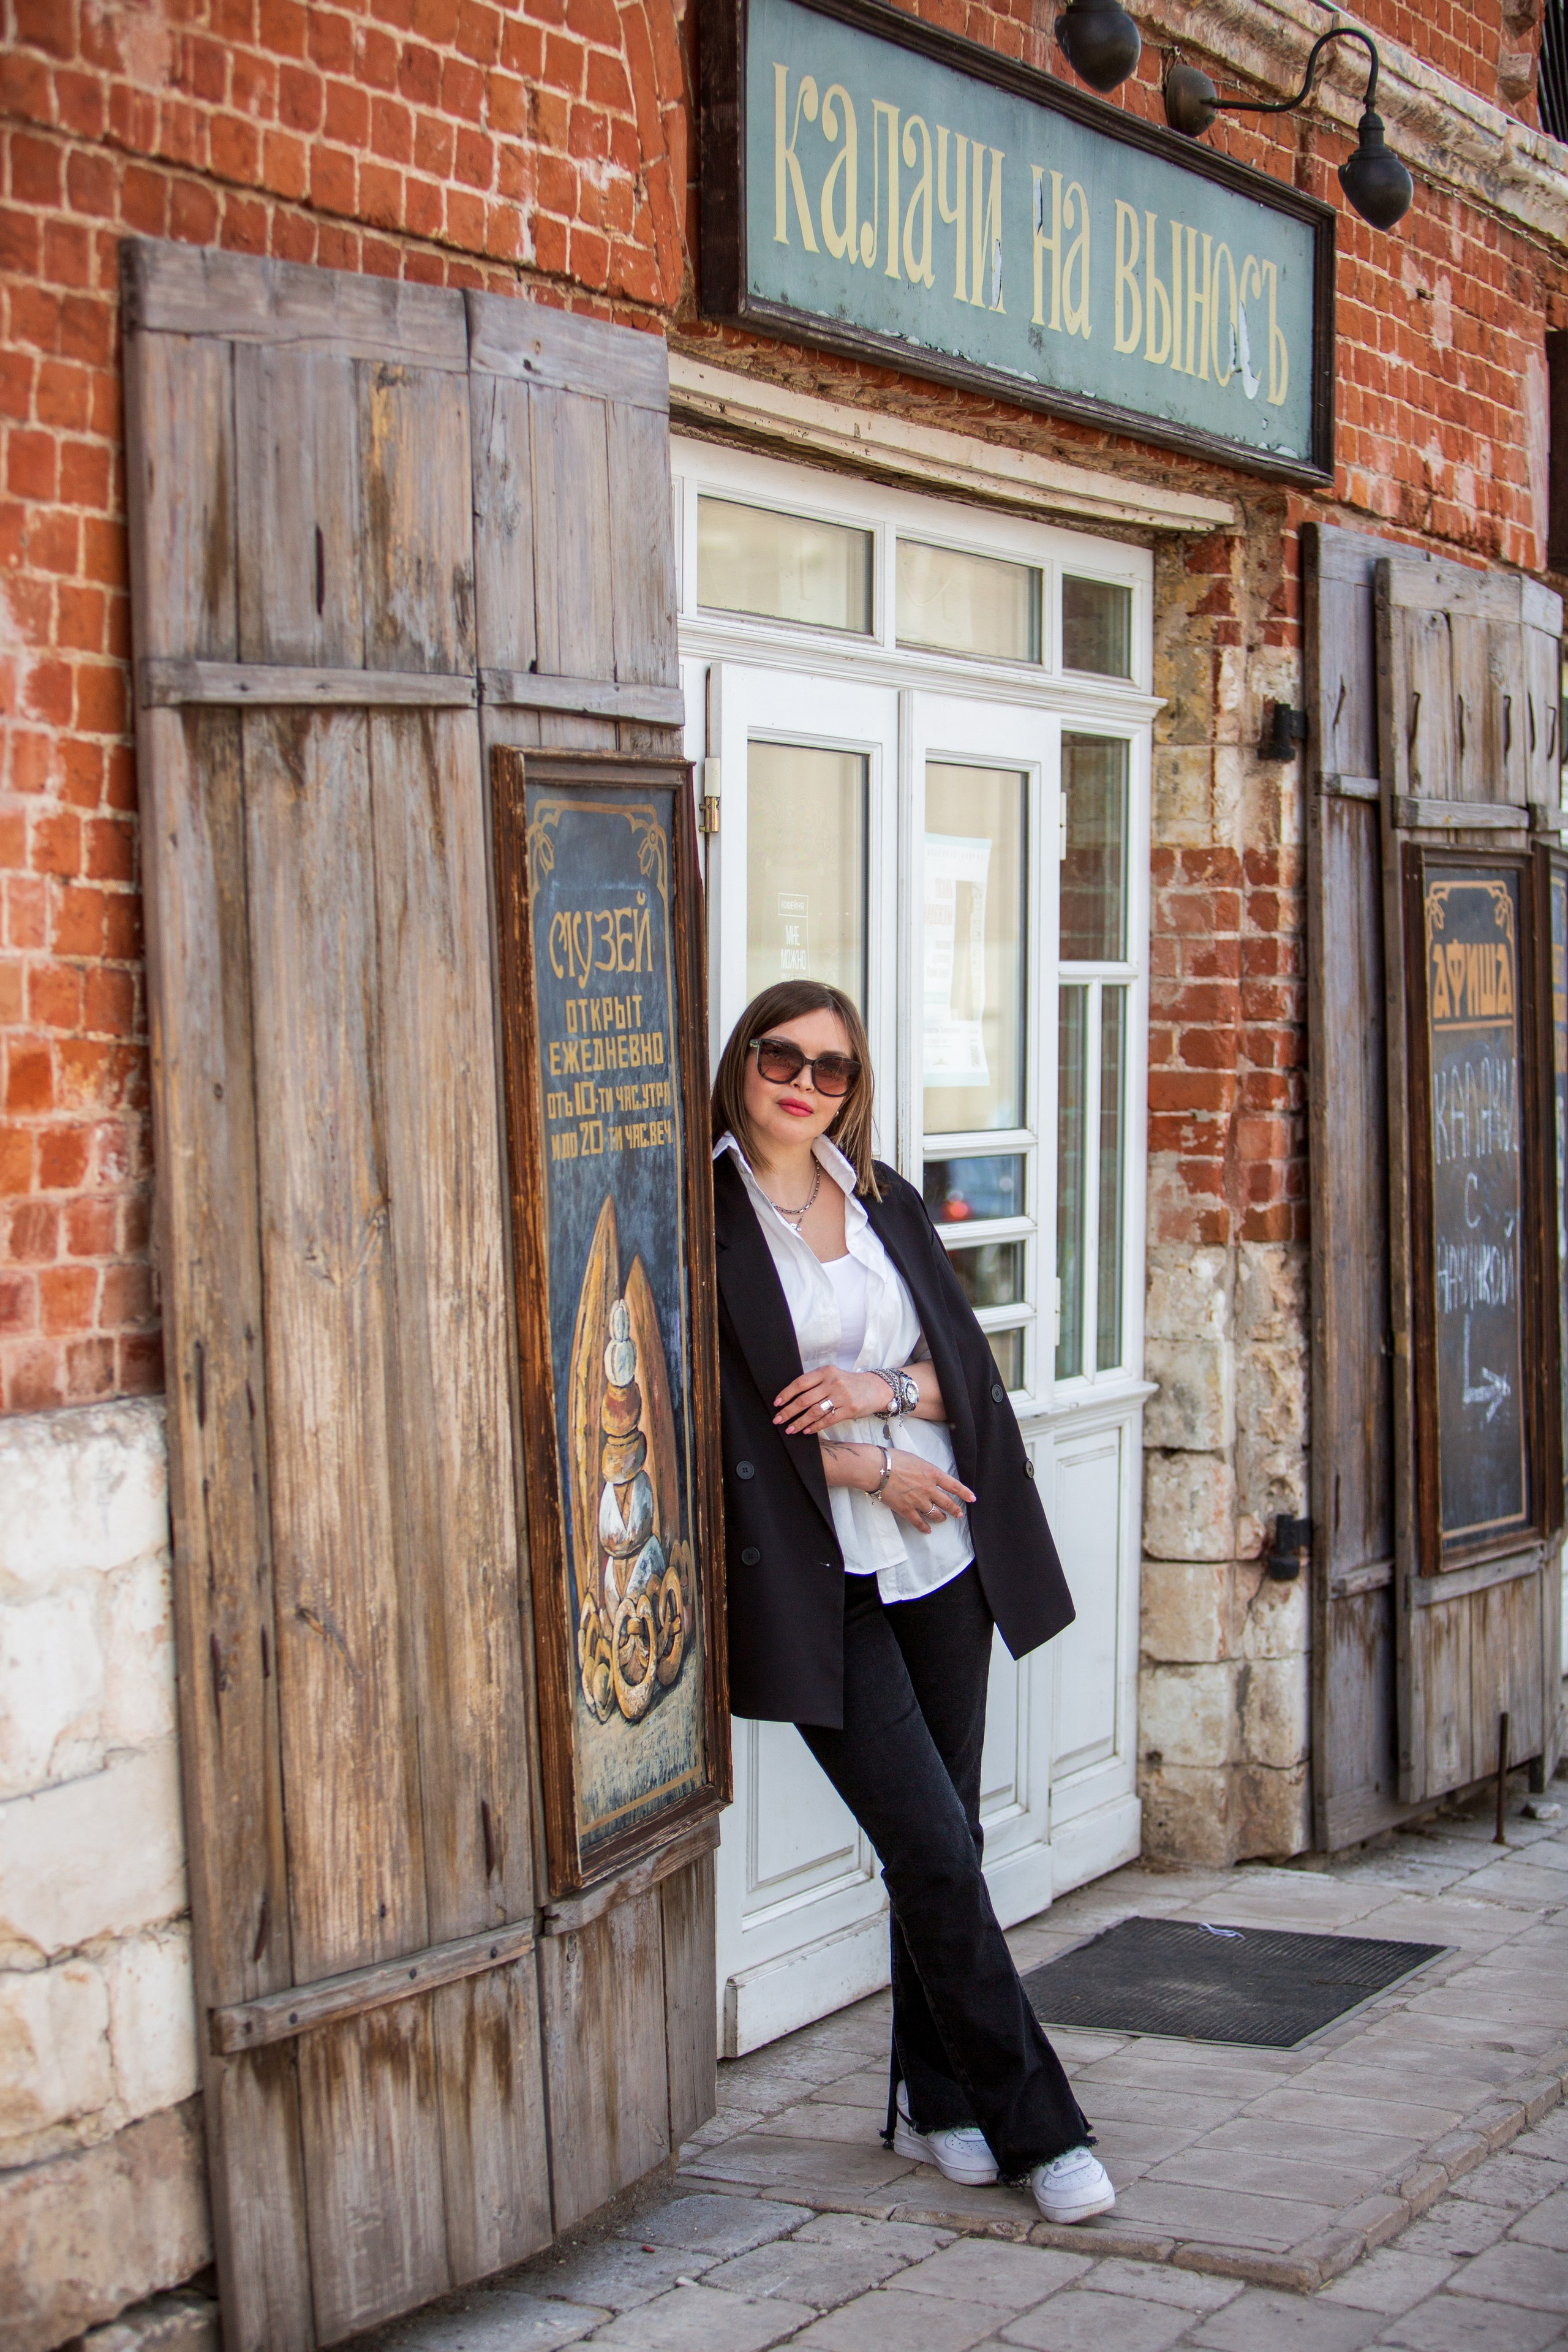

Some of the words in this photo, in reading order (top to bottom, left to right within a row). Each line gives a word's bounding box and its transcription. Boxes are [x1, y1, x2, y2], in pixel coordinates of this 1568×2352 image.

[549, 891, 654, 990] МУЗЕЙ
[785, 925, 801, 946] МНЕ
[780, 948, 807, 971] МОЖНО
[1432, 938, 1513, 1019] АФИША
[565, 994, 643, 1034] ОТКРЫТ
[549, 1031, 665, 1076] ЕЖЕДНЕВНО
[546, 1091, 573, 1120] ОТЪ
